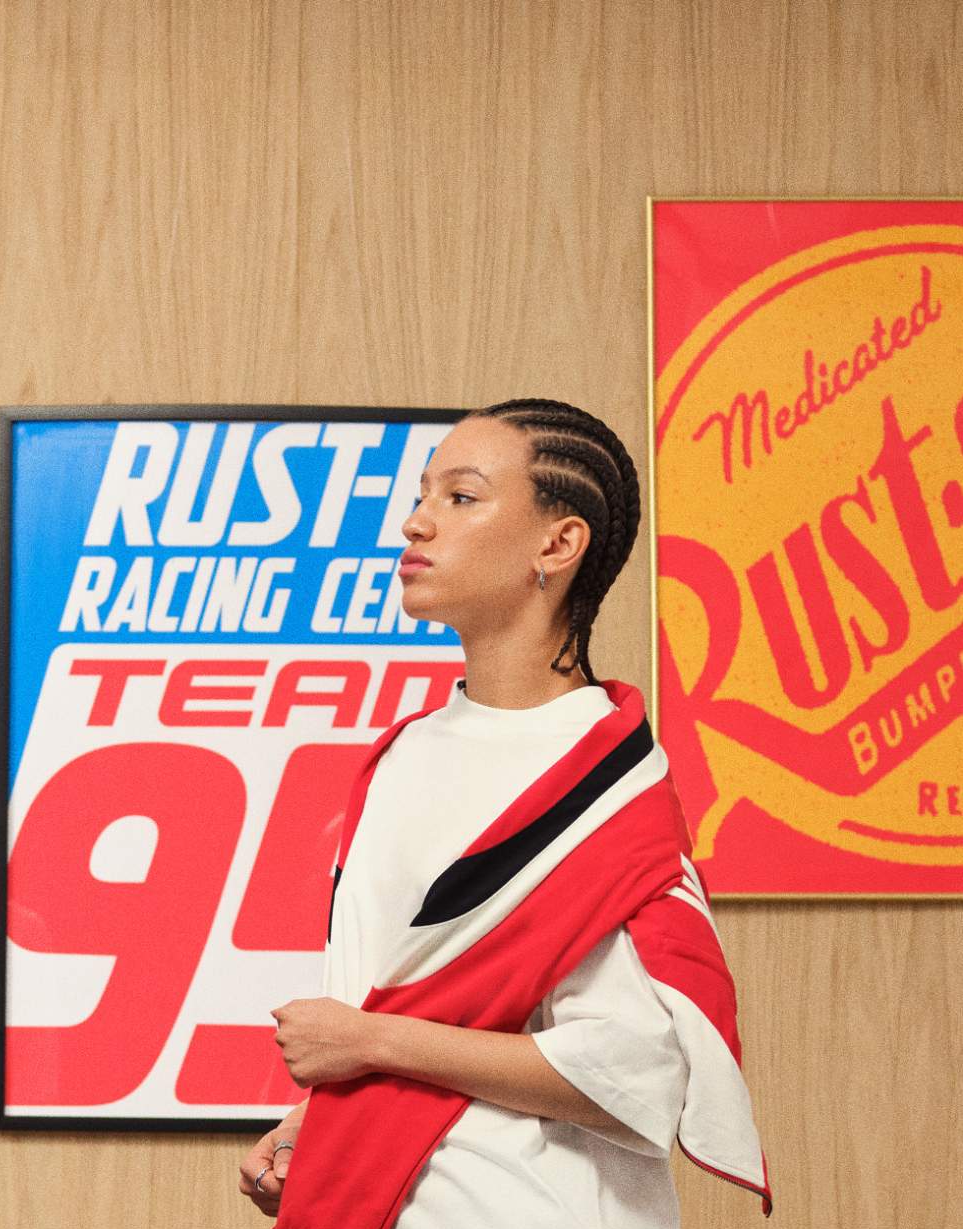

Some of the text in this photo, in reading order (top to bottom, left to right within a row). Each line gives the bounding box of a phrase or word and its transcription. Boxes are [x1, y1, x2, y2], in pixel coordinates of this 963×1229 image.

[692, 265, 941, 484] Medicated
[58, 556, 445, 634] RACING CEN
[69, 660, 468, 729] TEAM
[847, 651, 963, 777] BUMP
